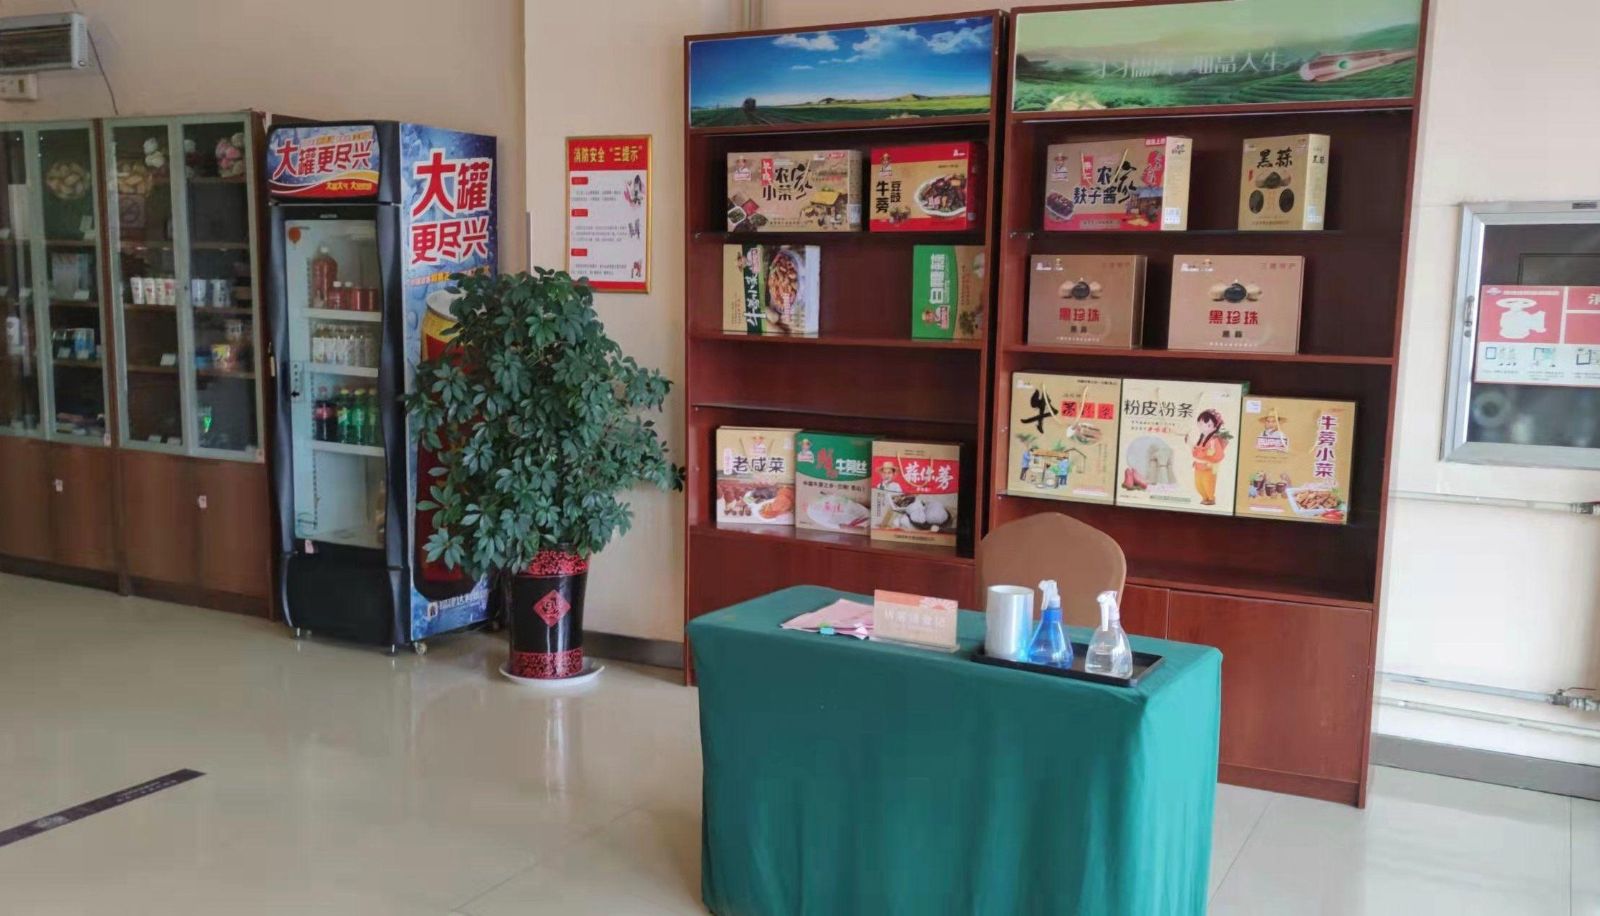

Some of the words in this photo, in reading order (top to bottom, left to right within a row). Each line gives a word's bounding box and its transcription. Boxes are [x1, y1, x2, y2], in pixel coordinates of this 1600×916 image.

[273, 139, 372, 179] 大罐更尽兴
[1256, 146, 1293, 168] 黑蒜
[412, 152, 490, 217] 大罐
[763, 184, 793, 201] 小菜
[876, 180, 889, 213] 牛蒡
[411, 218, 488, 264] 更尽兴
[1208, 310, 1259, 325] 黑珍珠
[1123, 400, 1193, 418] 粉皮粉条
[1315, 415, 1337, 478] 牛蒡小菜
[733, 456, 785, 473] 老咸菜
